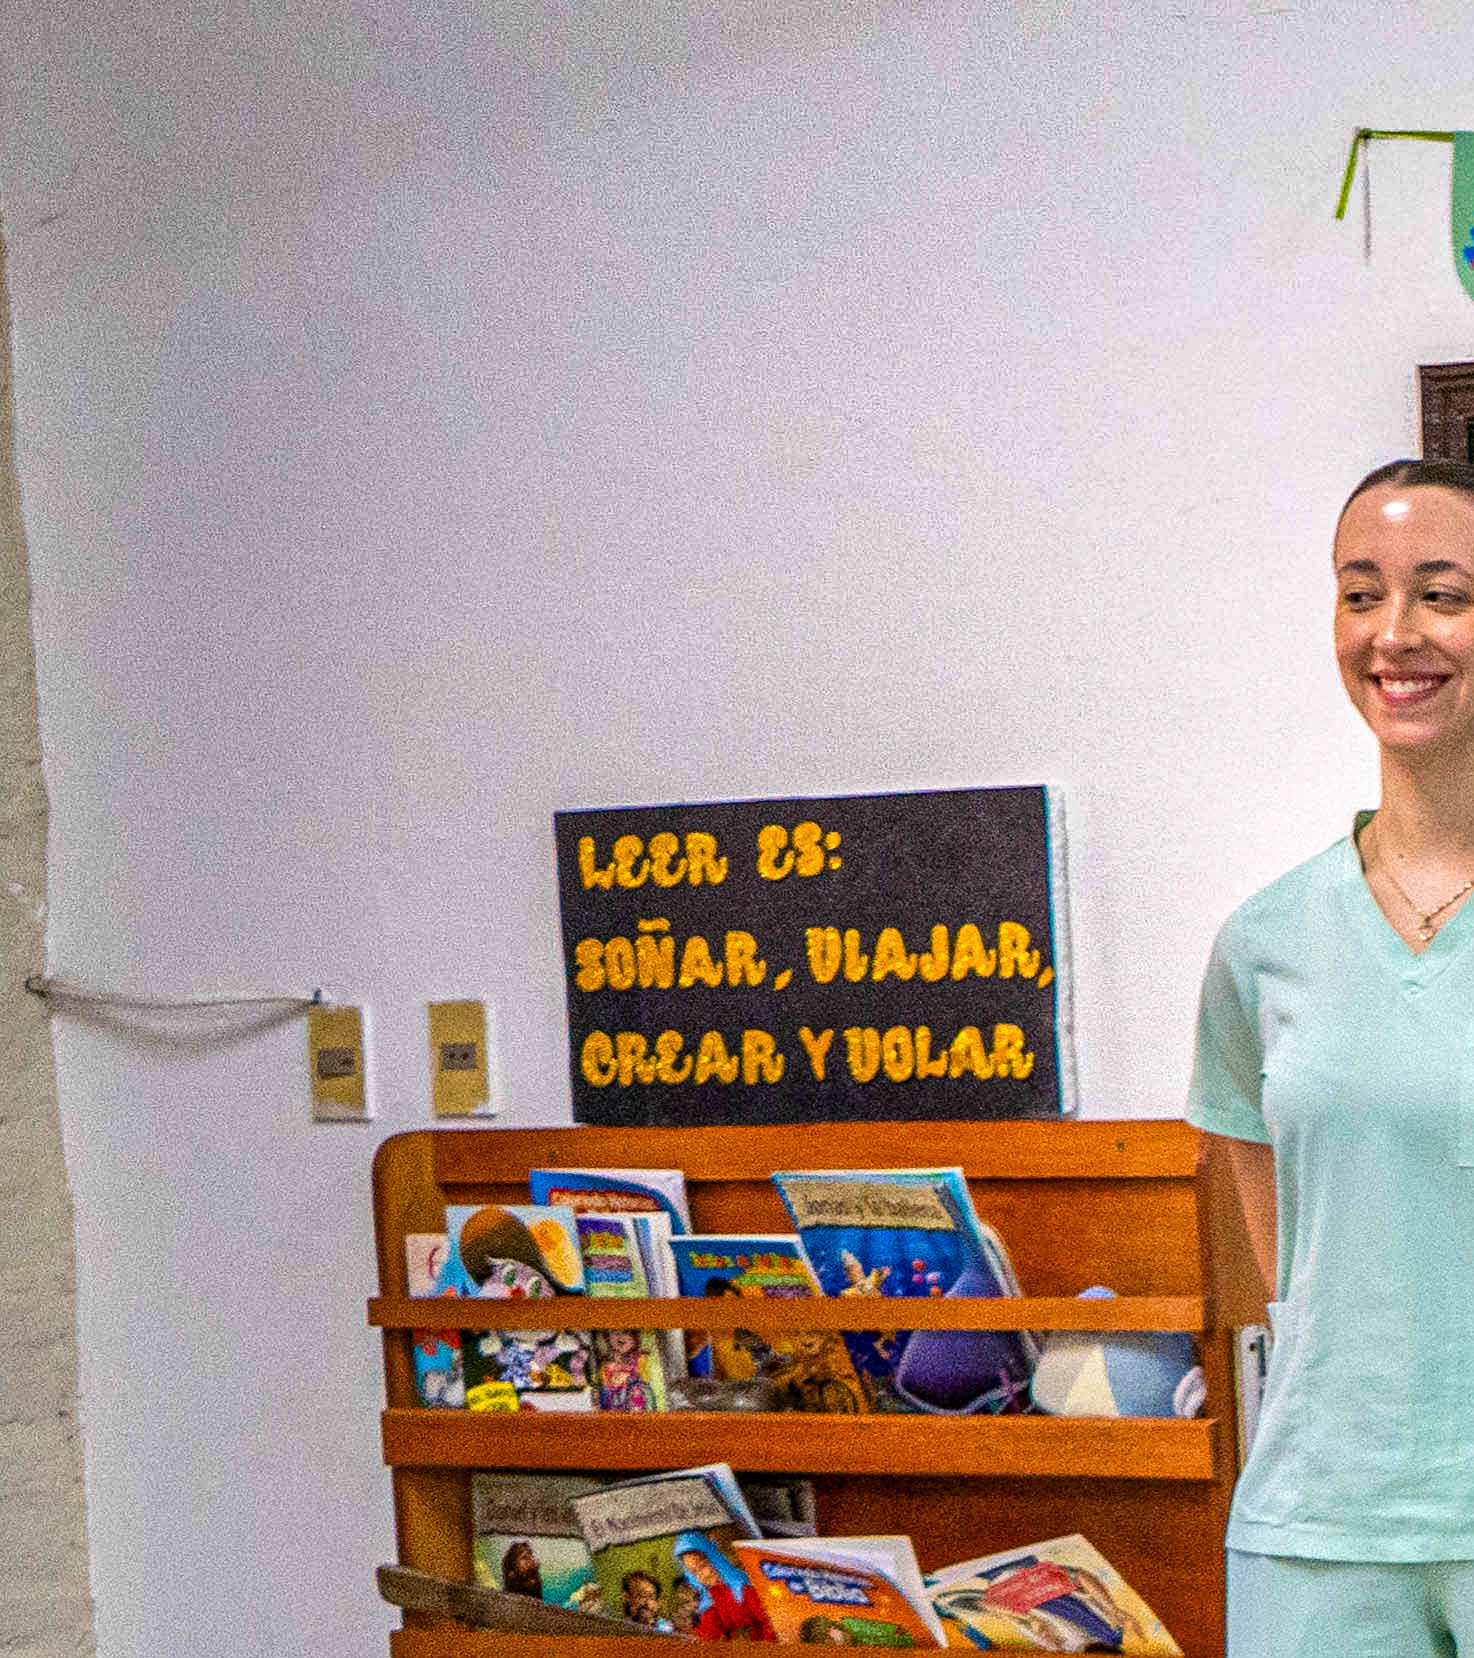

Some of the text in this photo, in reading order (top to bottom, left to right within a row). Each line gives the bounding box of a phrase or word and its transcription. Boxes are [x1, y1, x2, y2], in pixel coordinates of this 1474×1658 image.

[577, 820, 843, 890] LEER ES:
[574, 917, 1055, 992] SOÑAR, VIAJAR,
[579, 1023, 1036, 1088] CREAR Y VOLAR
